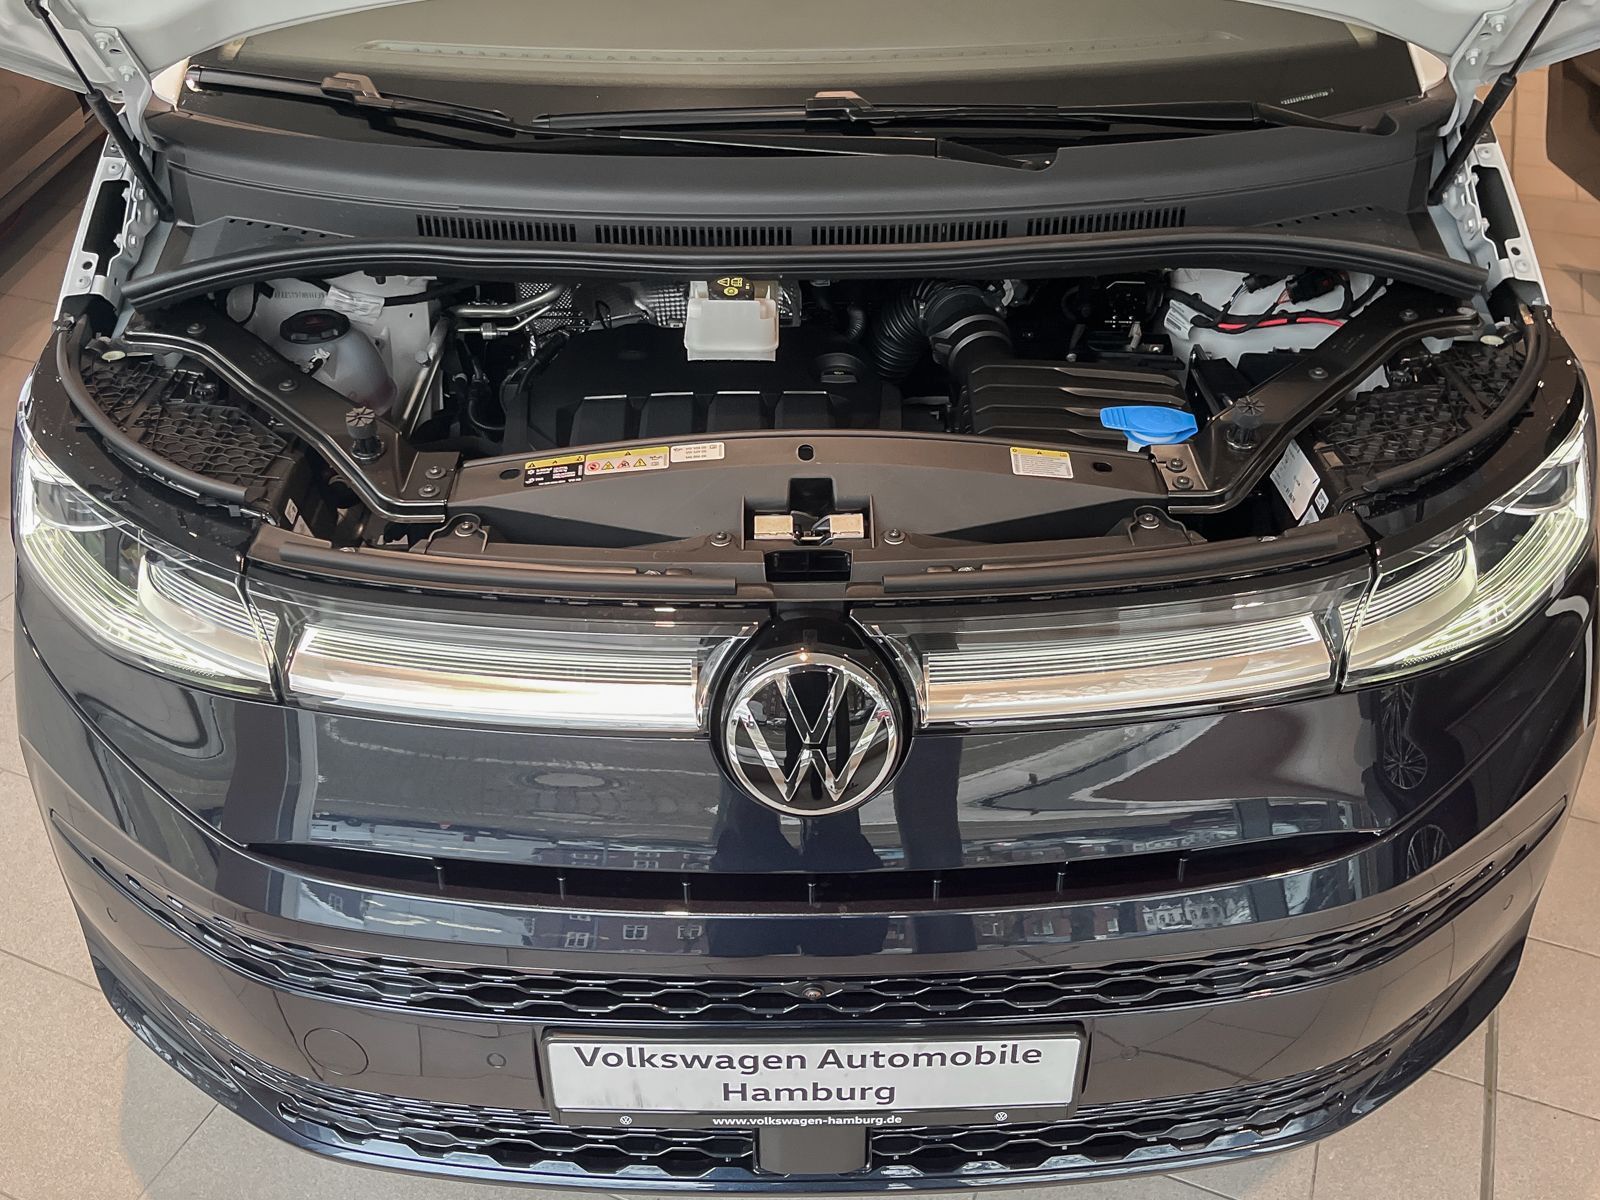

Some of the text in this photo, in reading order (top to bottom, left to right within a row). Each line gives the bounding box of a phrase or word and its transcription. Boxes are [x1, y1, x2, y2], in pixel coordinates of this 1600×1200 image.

[727, 654, 896, 814] VW
[574, 1043, 1042, 1075] Volkswagen Automobile
[723, 1082, 896, 1105] Hamburg
[712, 1115, 902, 1127] www.volkswagen-hamburg.de
